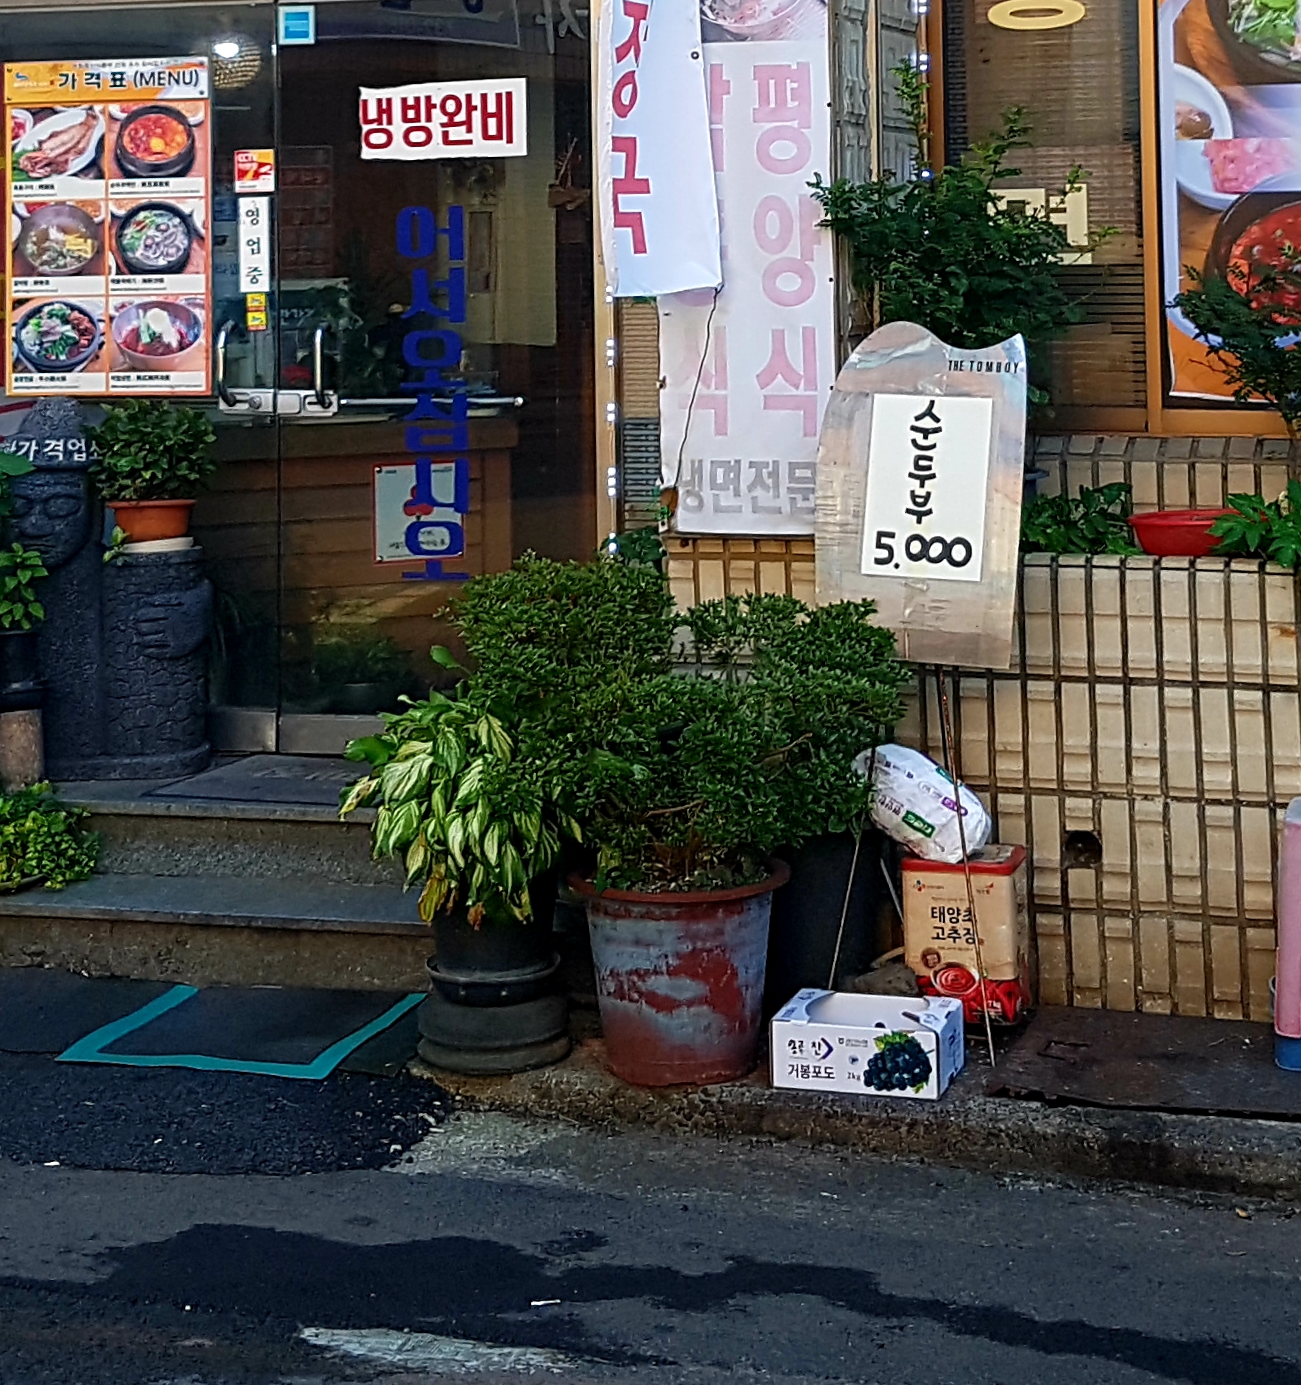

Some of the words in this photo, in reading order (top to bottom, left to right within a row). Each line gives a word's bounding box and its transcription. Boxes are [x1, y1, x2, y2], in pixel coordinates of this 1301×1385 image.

[133, 69, 199, 88] (MENU)
[360, 91, 514, 149] 냉방완비
[752, 61, 821, 438] 평양식
[905, 399, 943, 525] 순두부
[787, 1063, 835, 1080] 거봉포도
